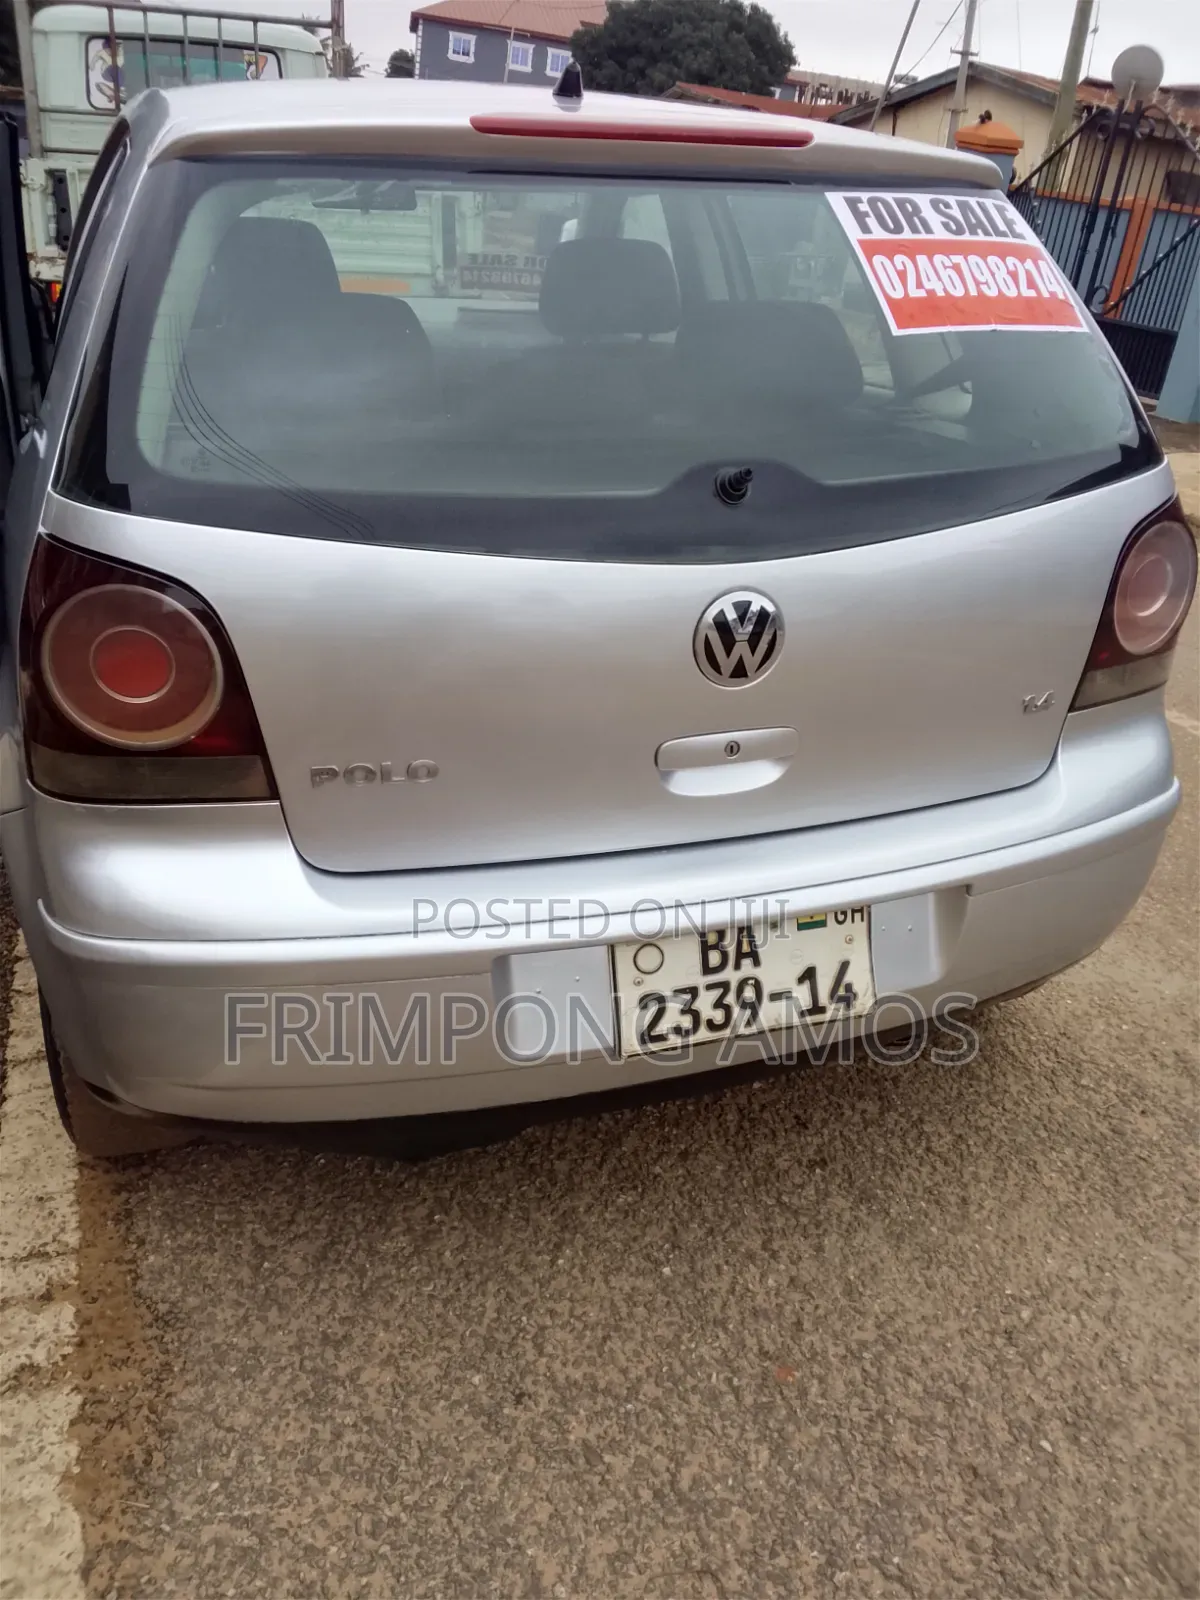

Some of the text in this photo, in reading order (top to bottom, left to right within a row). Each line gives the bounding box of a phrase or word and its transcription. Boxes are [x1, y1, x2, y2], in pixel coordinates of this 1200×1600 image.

[842, 195, 1028, 240] FOR SALE
[872, 254, 1067, 300] 0246798214
[310, 759, 440, 788] POLO
[833, 907, 866, 926] GH
[701, 924, 761, 976] BA
[637, 960, 858, 1046] 2339-14
